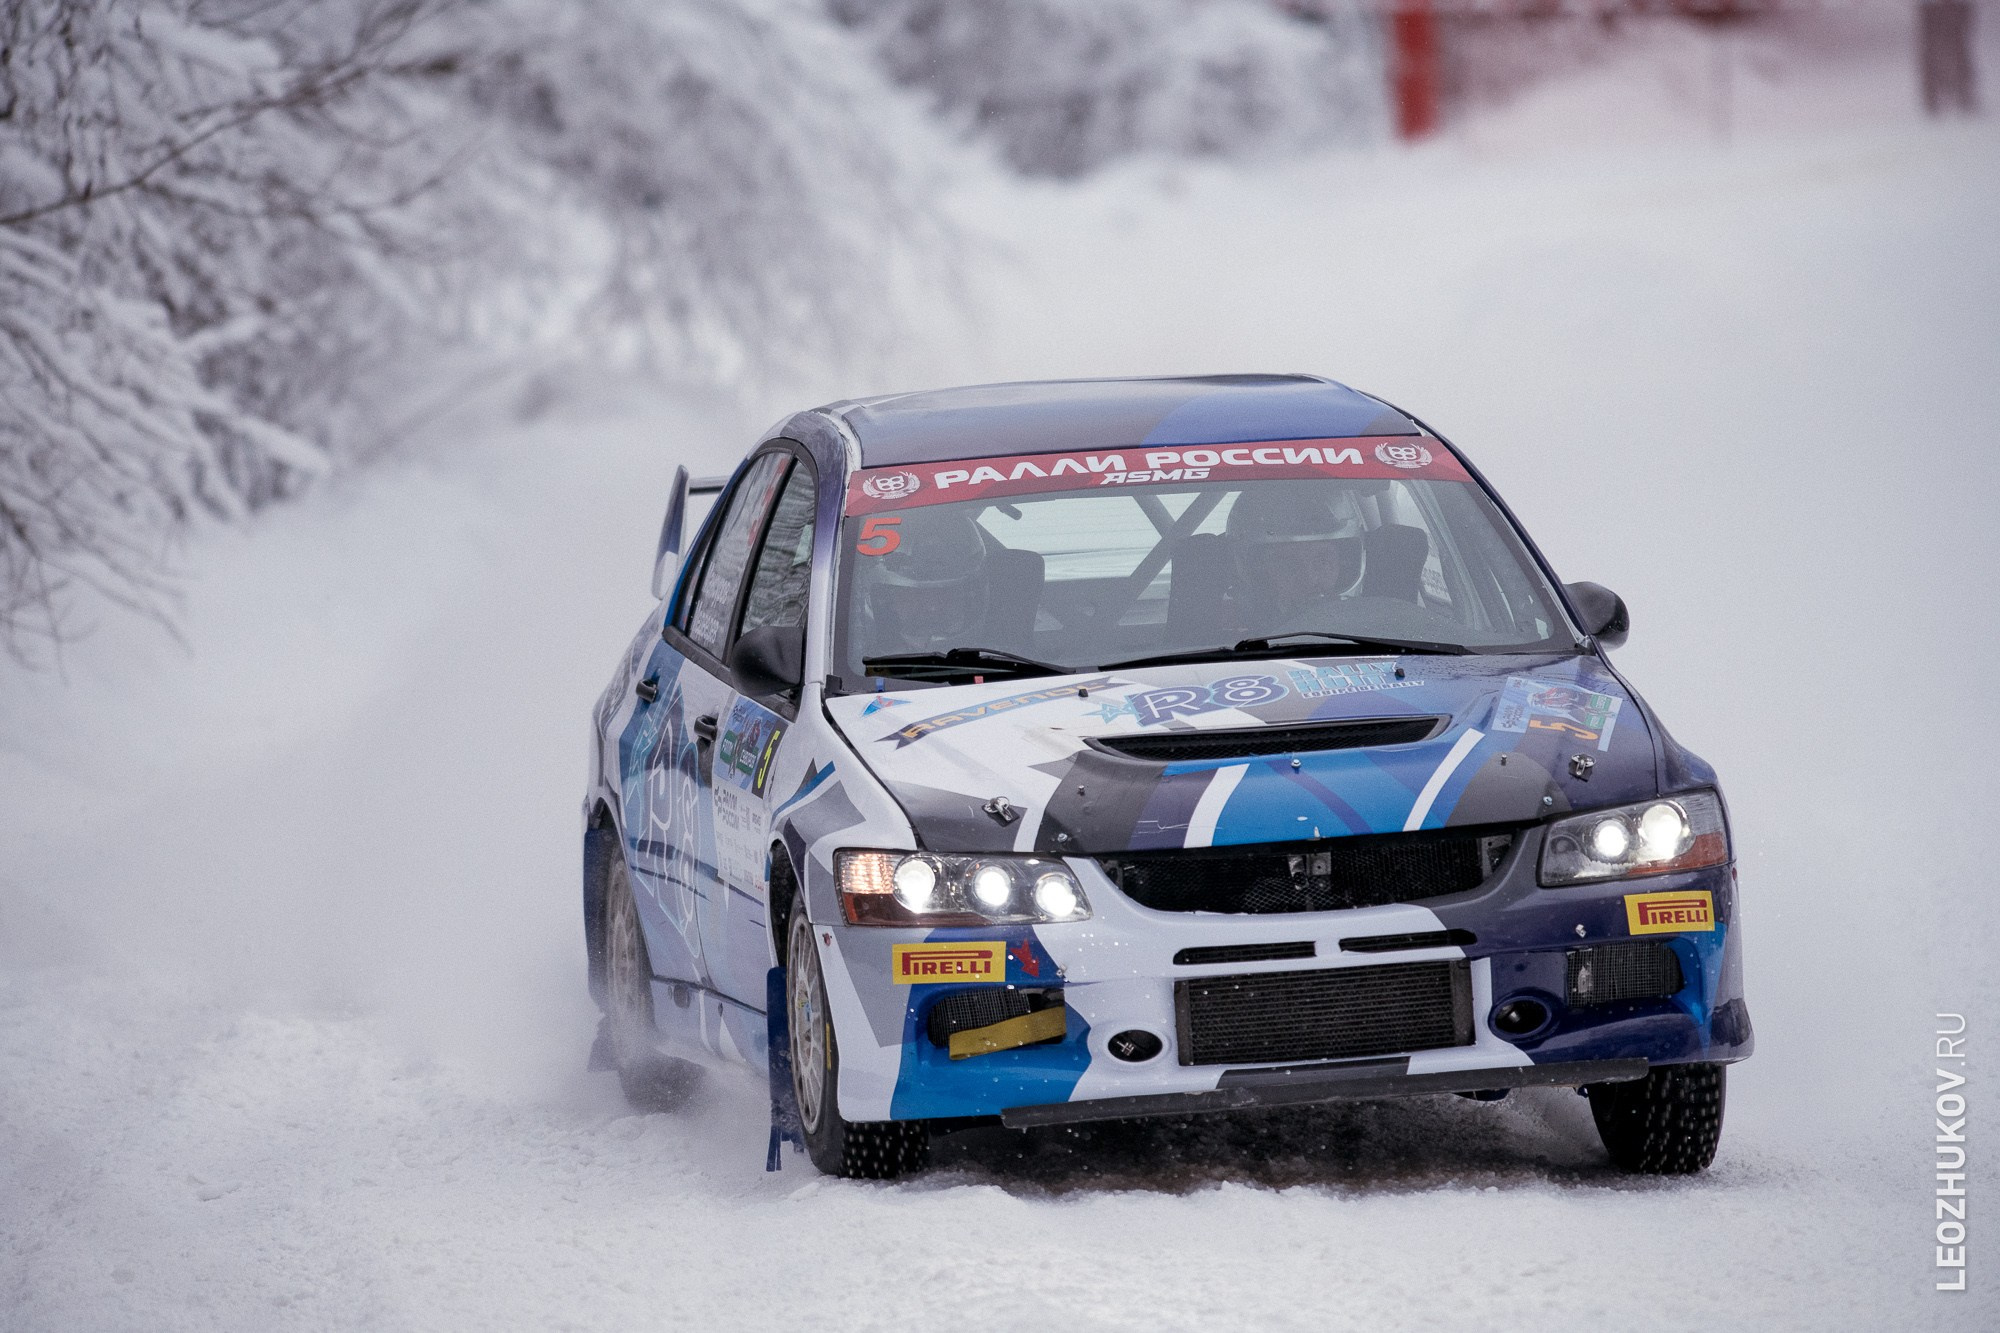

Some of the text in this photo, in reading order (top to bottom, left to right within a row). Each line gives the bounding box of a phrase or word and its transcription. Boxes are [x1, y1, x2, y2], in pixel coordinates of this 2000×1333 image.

[934, 448, 1364, 489] РАЛЛИ РОССИИ
[856, 518, 902, 556] 5
[903, 684, 1106, 738] RAVENOL
[1126, 675, 1290, 727] R8
[1529, 719, 1599, 740] 5
[756, 730, 781, 789] 5
[1637, 899, 1708, 926] PIRELLI
[902, 950, 993, 976] PIRELLI
